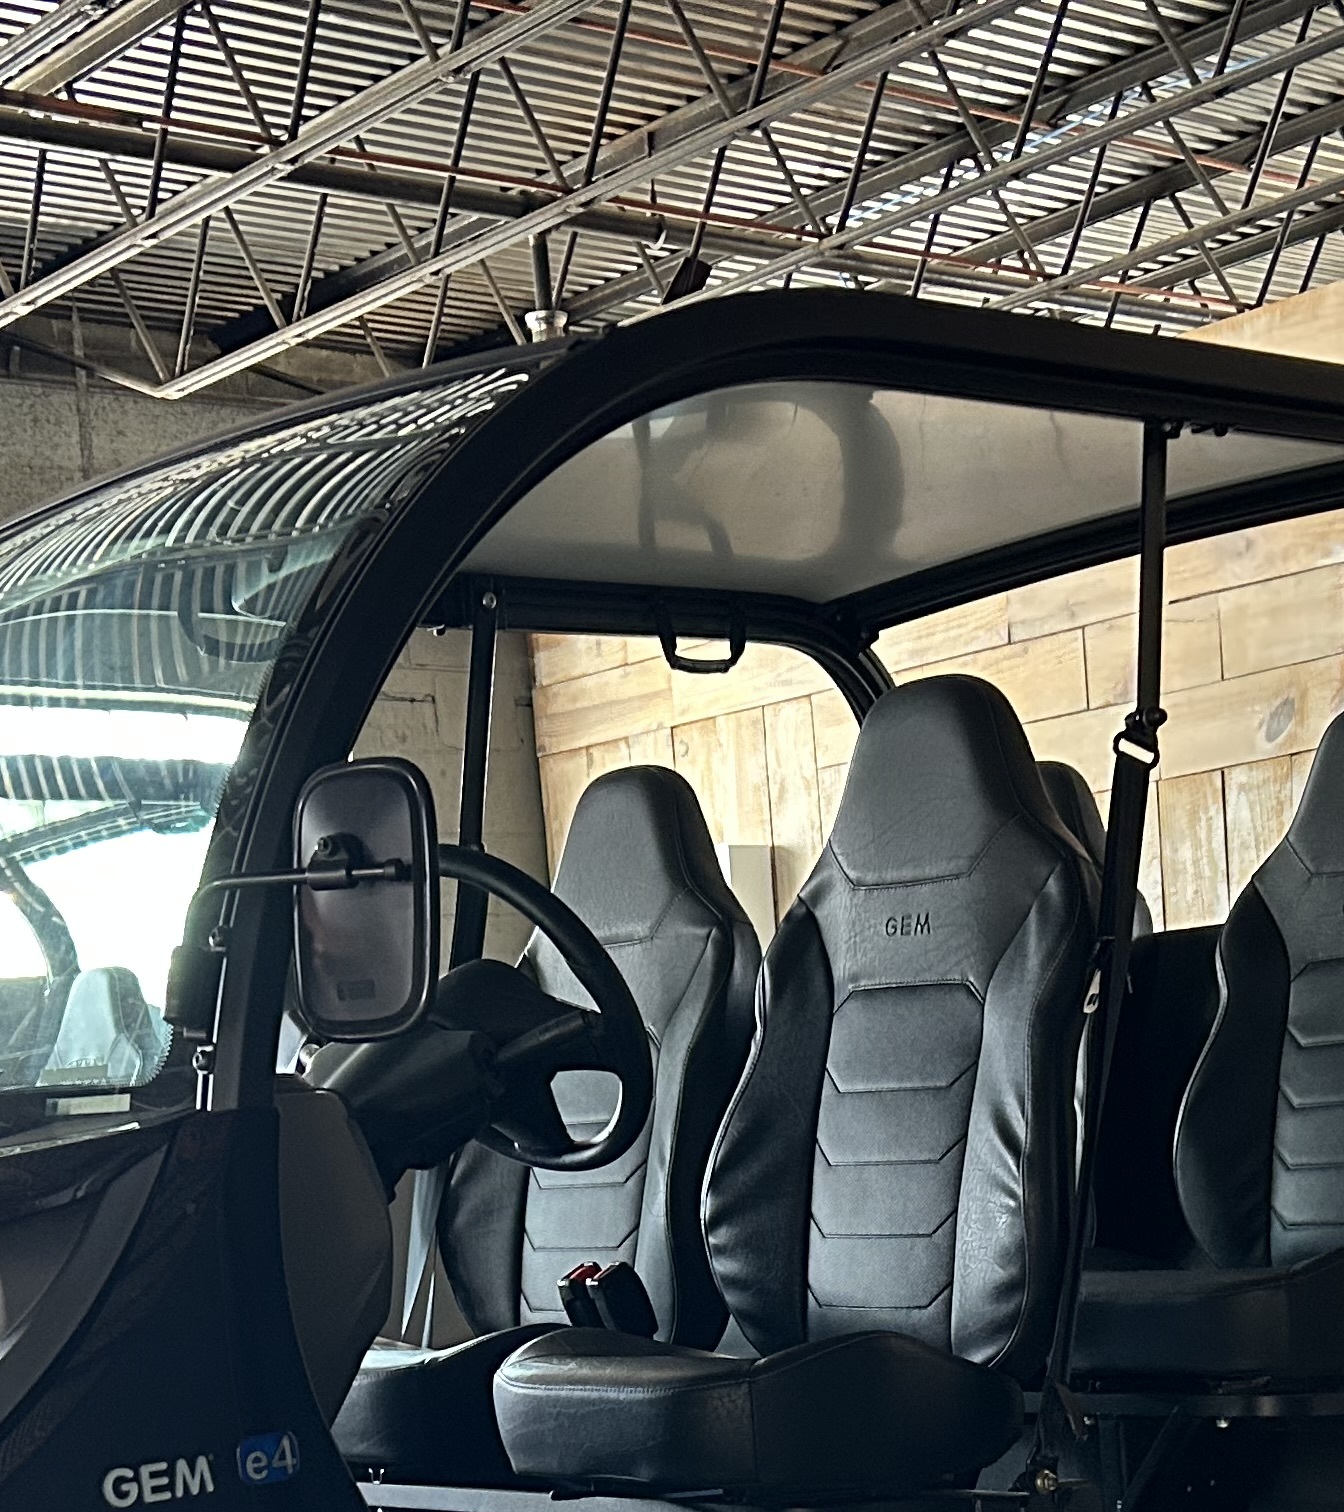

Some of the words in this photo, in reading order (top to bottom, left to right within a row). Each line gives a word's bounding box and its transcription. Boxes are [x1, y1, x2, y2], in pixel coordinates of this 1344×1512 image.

[885, 911, 931, 937] GEM
[102, 1454, 215, 1508] GEM
[245, 1434, 297, 1480] e4
